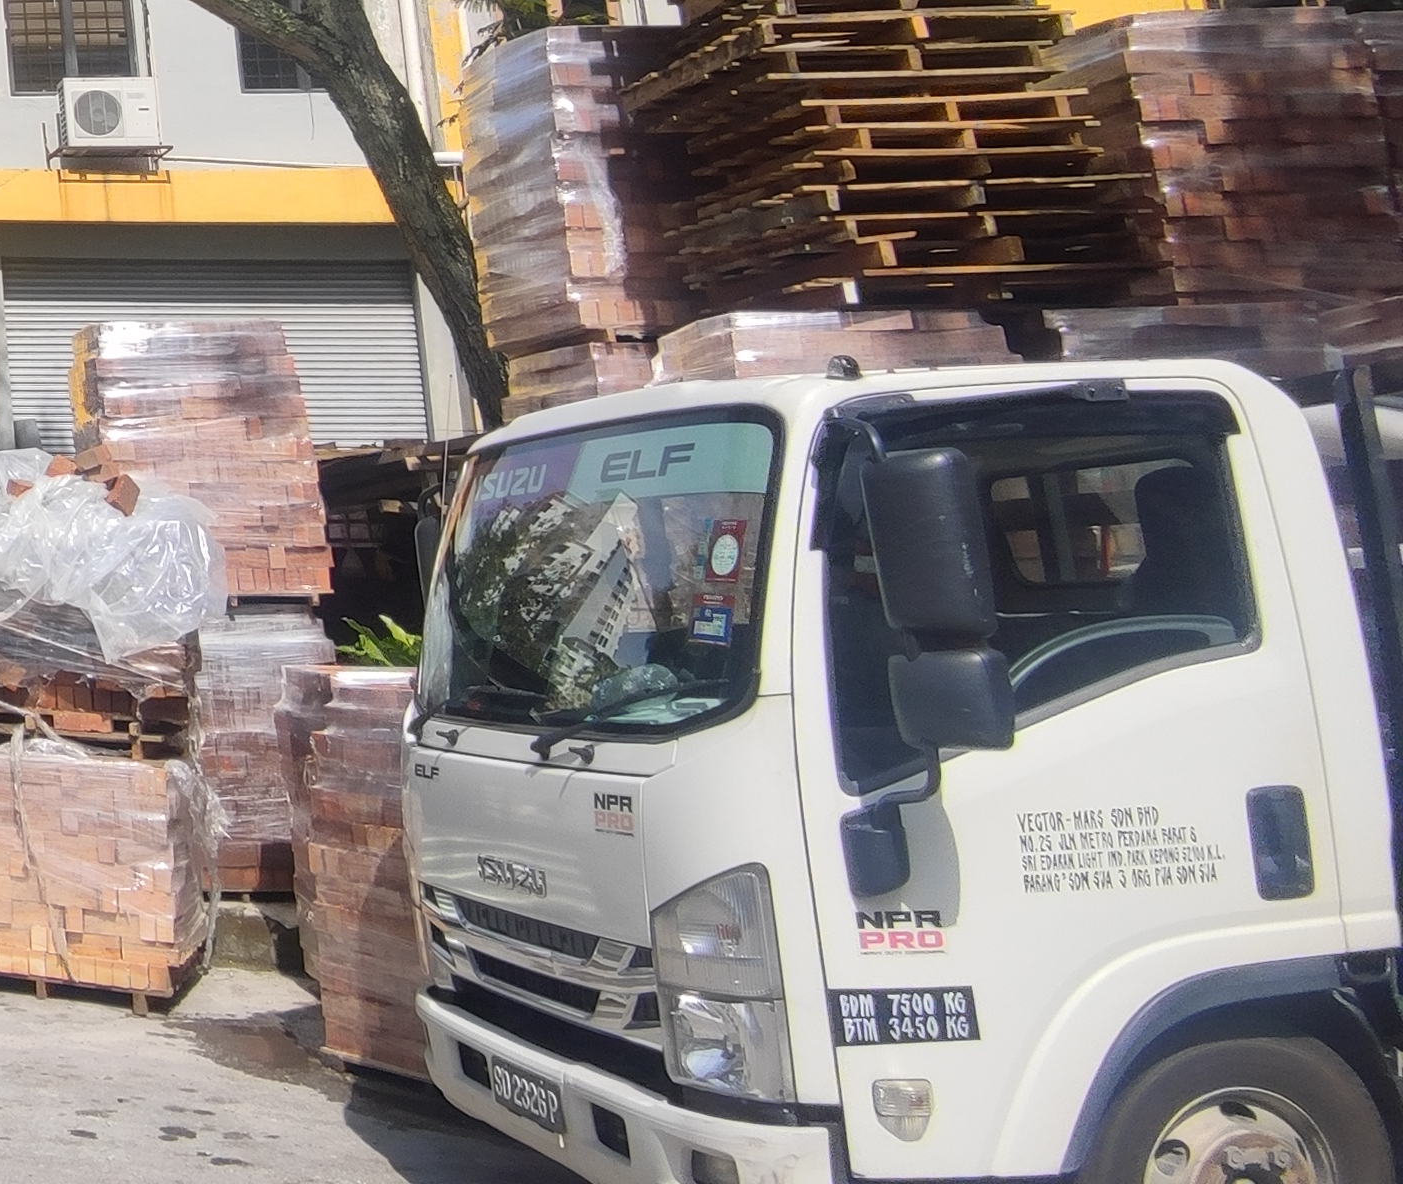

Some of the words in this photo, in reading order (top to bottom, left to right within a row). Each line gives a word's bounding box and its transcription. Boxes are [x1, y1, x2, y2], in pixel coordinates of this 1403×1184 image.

[474, 464, 547, 501] ISUZU
[600, 442, 695, 483] ELF
[414, 763, 439, 780] ELF
[594, 792, 633, 814] NPR
[595, 810, 634, 831] PRO
[1111, 807, 1134, 828] SDN
[1137, 806, 1159, 827] BHD
[1058, 833, 1077, 850] JLN
[1080, 831, 1113, 849] METRO
[1117, 828, 1159, 847] PERDANA
[1022, 855, 1037, 871] SRI
[1077, 851, 1103, 869] LIGHT
[477, 853, 547, 898] ISUZU
[1068, 871, 1091, 891] SDN
[1118, 869, 1127, 889] 3
[1132, 868, 1151, 888] ORG
[1176, 864, 1197, 885] SDN
[855, 910, 943, 929] NPR
[859, 930, 944, 949] PRO
[839, 993, 875, 1017] BDM
[887, 992, 935, 1016] 7500
[943, 991, 966, 1015] KG
[843, 1017, 879, 1043] BTM
[888, 1016, 939, 1040] 3450
[946, 1015, 969, 1039] KG
